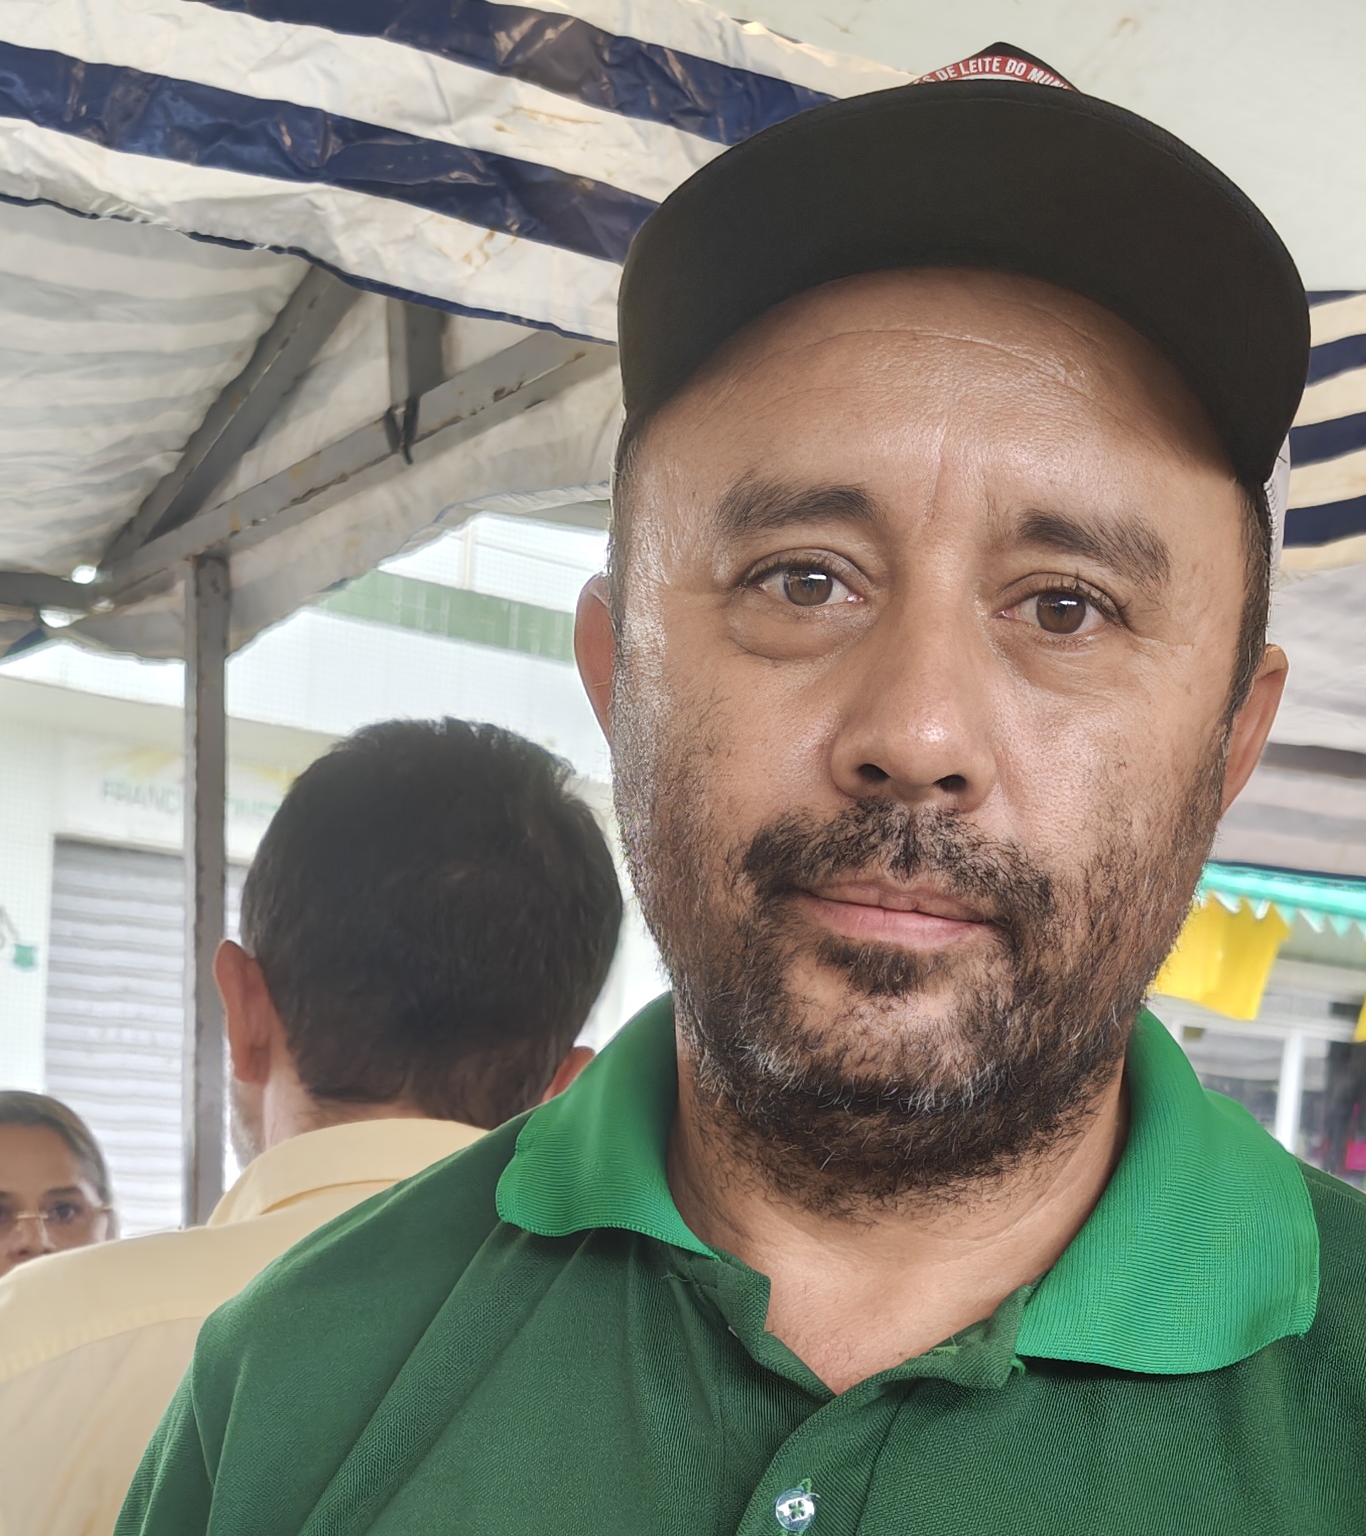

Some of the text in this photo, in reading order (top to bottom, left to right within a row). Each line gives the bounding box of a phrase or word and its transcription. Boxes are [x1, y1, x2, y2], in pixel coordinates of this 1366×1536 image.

[935, 67, 958, 81] DE
[959, 56, 1003, 75] LEITE
[1005, 58, 1027, 75] DO
